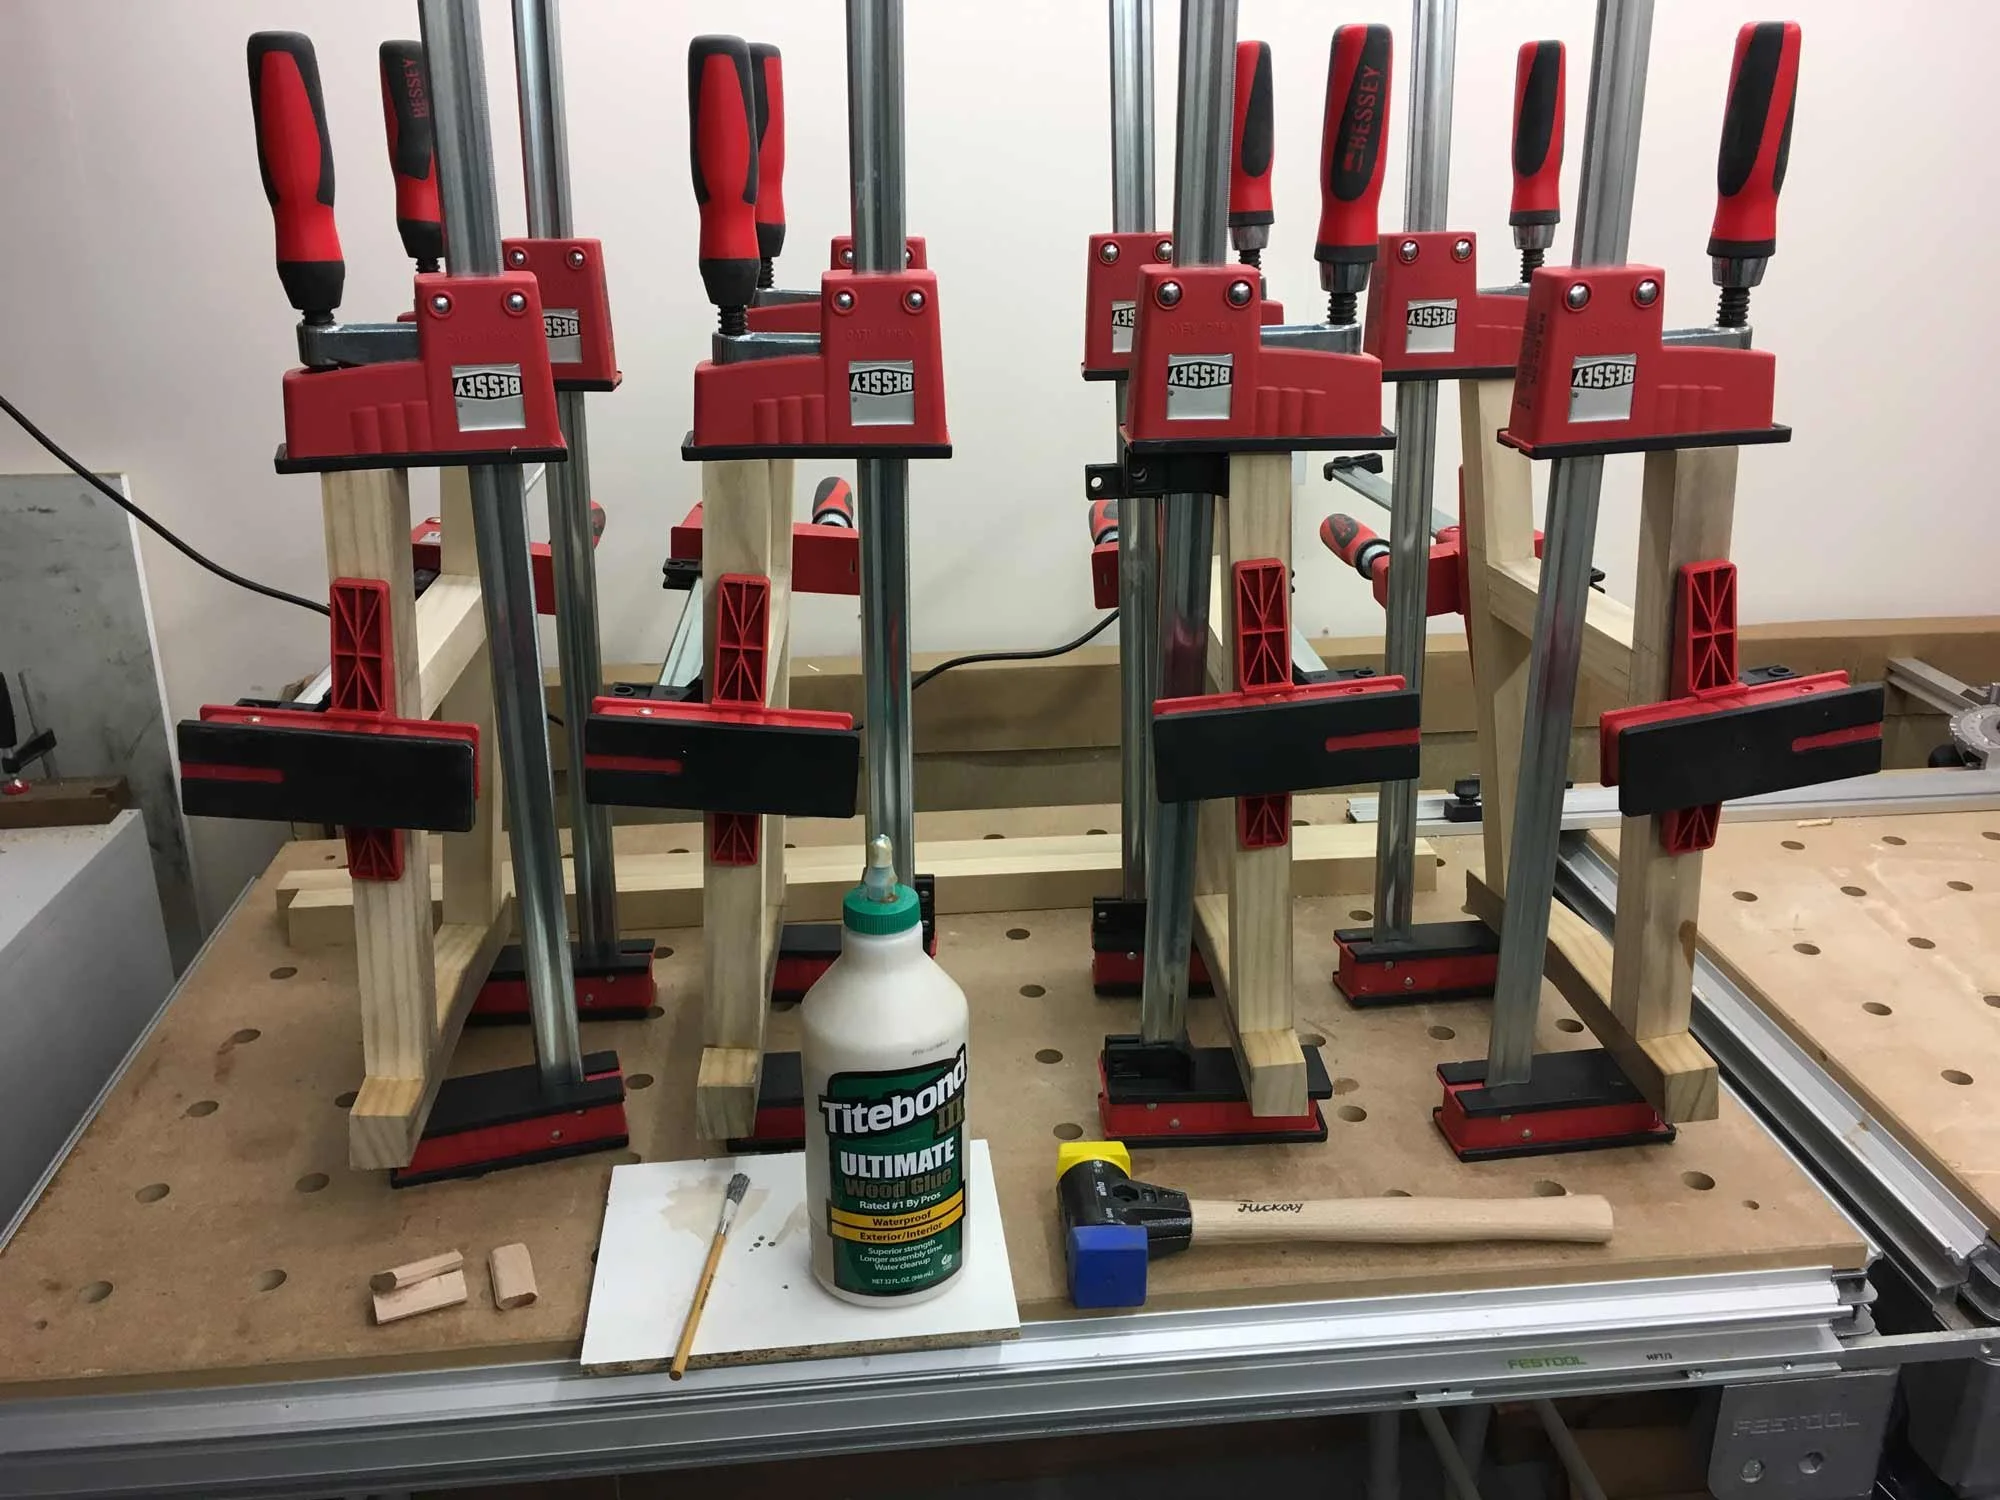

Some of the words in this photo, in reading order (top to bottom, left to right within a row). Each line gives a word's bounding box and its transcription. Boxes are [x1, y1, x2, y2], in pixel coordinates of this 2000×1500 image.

[403, 56, 429, 118] BESSEY
[1352, 64, 1379, 150] BESSEY
[544, 317, 579, 336] BESS
[1112, 309, 1135, 326] SEY
[1408, 308, 1455, 326] BESSEY
[851, 371, 913, 393] BESSEY
[1169, 364, 1230, 387] BESSEY
[1573, 365, 1635, 388] BESSEY
[455, 375, 521, 398] BESSEY
[821, 1050, 966, 1134] Titebond
[840, 1136, 955, 1179] ULTIMATE
[844, 1178, 906, 1199] Wood
[911, 1167, 952, 1195] Glue
[859, 1201, 890, 1210] Rated
[892, 1201, 904, 1209] #1
[906, 1199, 919, 1209] By
[921, 1192, 941, 1204] Pros
[1237, 1203, 1304, 1213] Hickory
[872, 1210, 932, 1227] Waterproof
[860, 1222, 943, 1241] Exterior/Interior
[860, 1255, 888, 1265] Longer
[889, 1250, 926, 1263] assembly
[927, 1244, 943, 1254] time
[868, 1247, 902, 1256] Superior
[903, 1239, 936, 1253] strength
[875, 1263, 899, 1271] Water
[899, 1257, 931, 1269] cleanup
[1507, 1355, 1588, 1370] FESTOOL
[1731, 1409, 1860, 1438] FESTOOL
